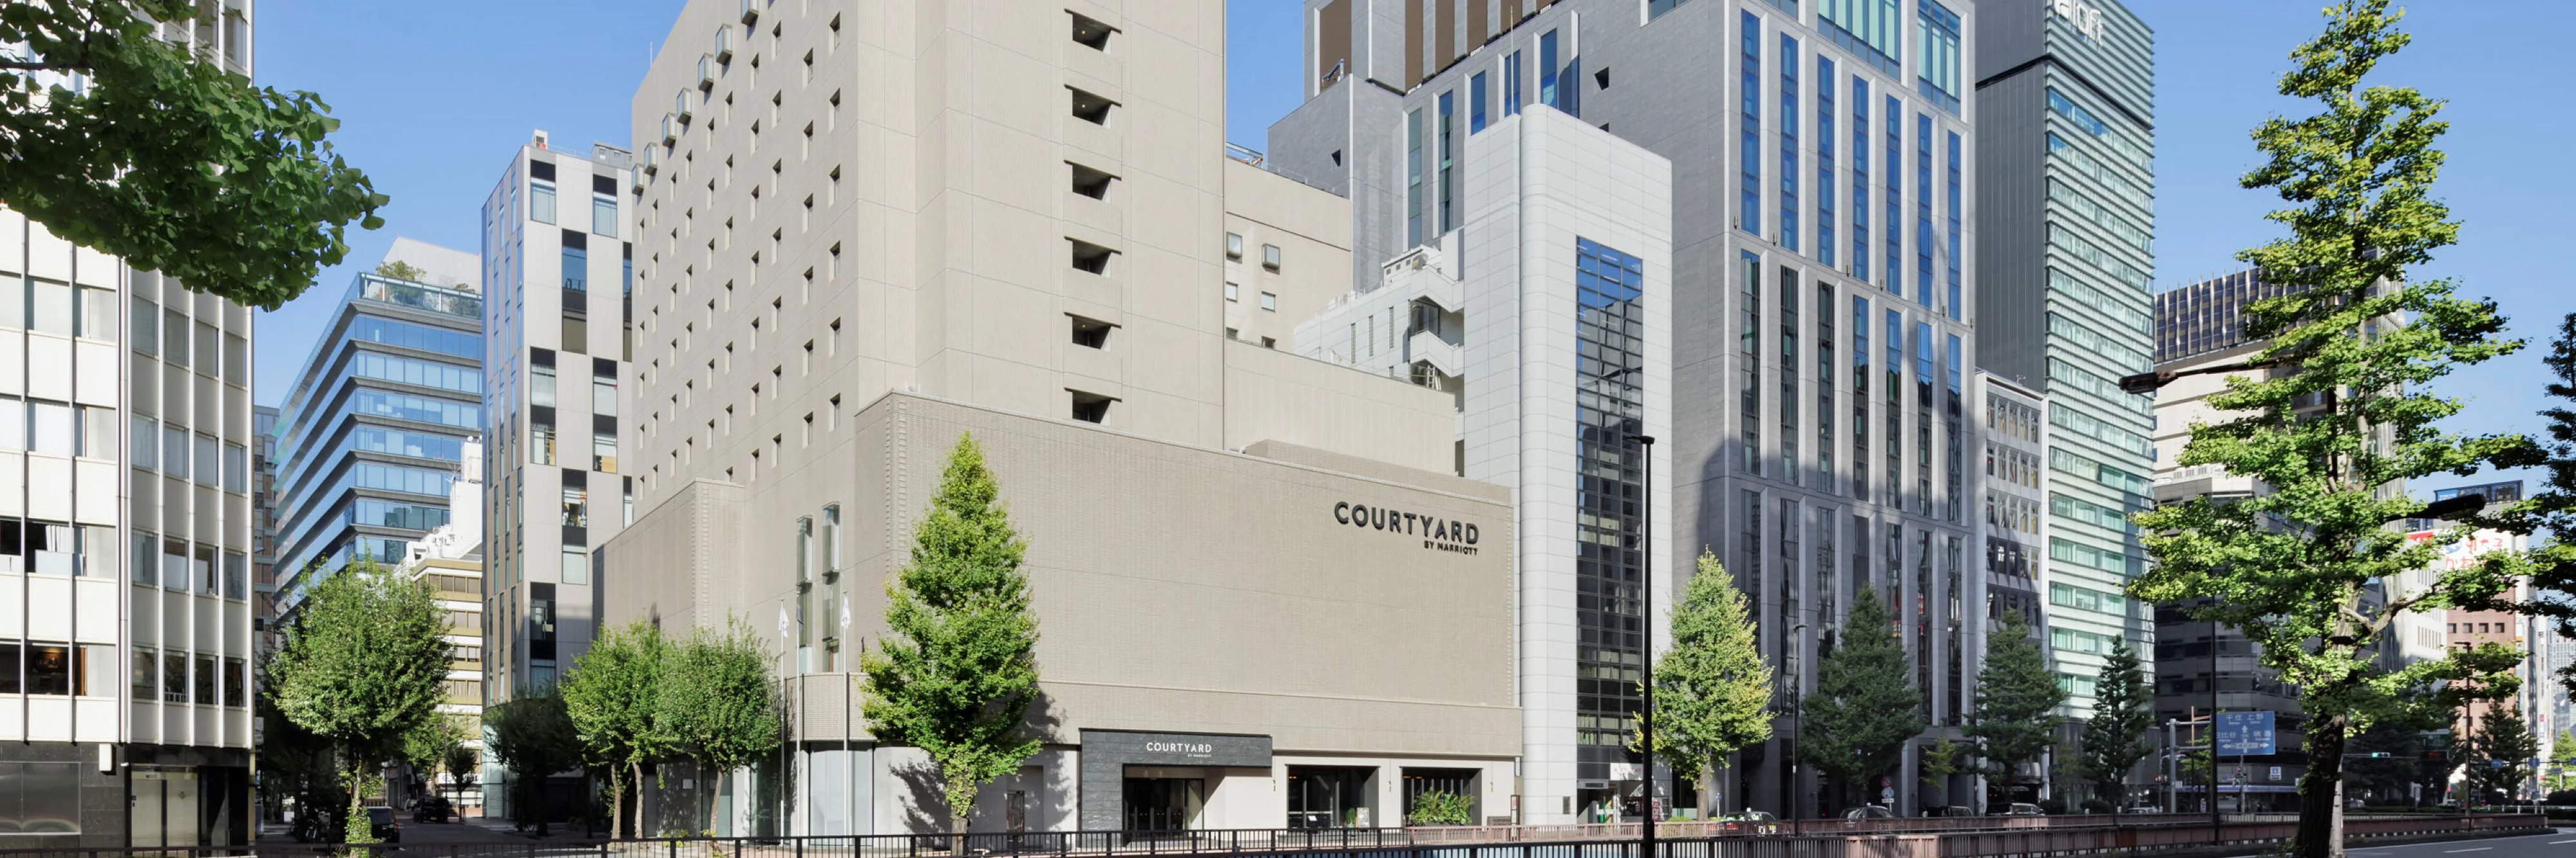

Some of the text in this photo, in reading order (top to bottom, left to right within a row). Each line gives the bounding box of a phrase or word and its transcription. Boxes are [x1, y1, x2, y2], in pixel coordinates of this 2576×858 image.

[2054, 0, 2103, 45] aloft
[1334, 501, 1479, 545] COURTYARD
[1424, 540, 1478, 556] BY MARRIOTT
[1146, 741, 1212, 753] COURTYARD
